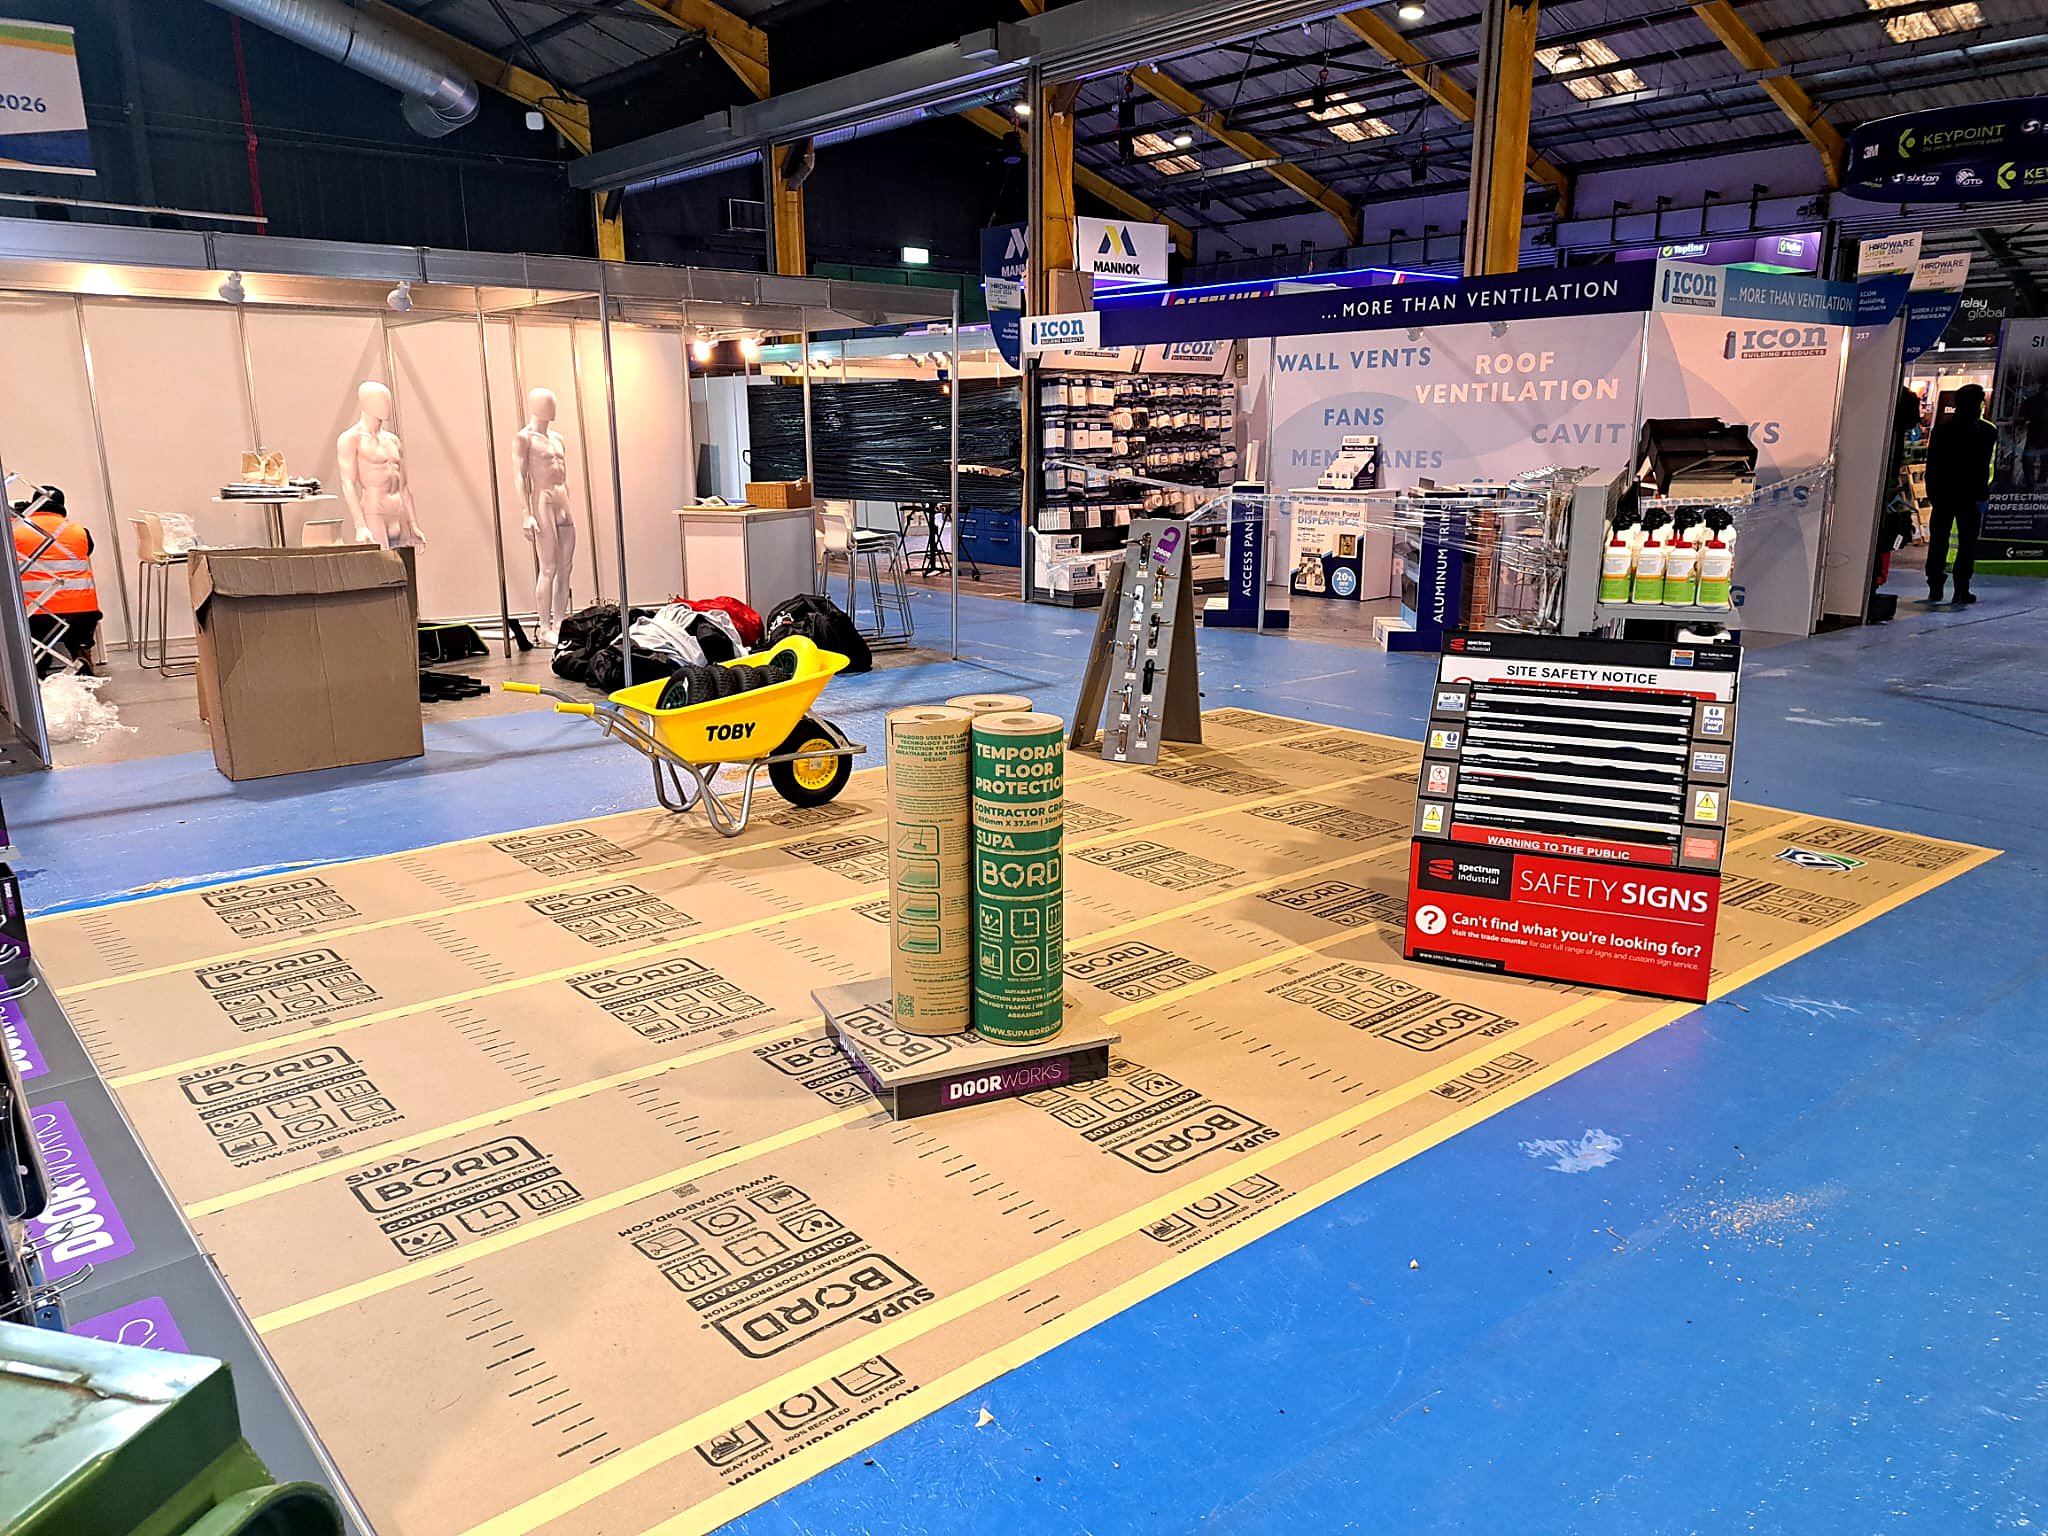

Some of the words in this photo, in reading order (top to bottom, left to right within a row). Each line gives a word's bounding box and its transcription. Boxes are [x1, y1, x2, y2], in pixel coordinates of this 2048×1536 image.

[1923, 125, 2006, 145] KEYPOINT
[1863, 144, 1879, 159] 3M
[1906, 173, 1939, 183] sixton
[1674, 244, 1705, 255] Topline
[1093, 261, 1140, 275] MANNOK
[1402, 294, 1457, 313] THAN
[1467, 279, 1619, 308] VENTILATION
[1769, 289, 1794, 306] THAN
[1797, 293, 1853, 312] VENTILATION
[1967, 307, 2006, 320] global
[1277, 350, 1340, 373] WALL
[1350, 346, 1432, 370] VENTS
[1475, 351, 1555, 375] ROOF
[1782, 349, 1826, 358] PRODUCTS
[1415, 377, 1619, 405] VENTILATION
[1323, 407, 1385, 426] FANS
[1243, 501, 1256, 548] PANELS
[1438, 502, 1452, 545] TRIMS
[1241, 551, 1253, 597] ACCESS
[1433, 549, 1450, 624] ALUMINUM
[1506, 665, 1537, 677] SITE
[1541, 667, 1598, 681] SAFETY
[1602, 671, 1658, 686] NOTICE
[705, 722, 756, 742] TOBY
[975, 742, 1064, 761] TEMPORAR
[995, 762, 1054, 779] FLOOR
[975, 776, 1064, 795] PROTECTIO
[975, 803, 1045, 818] CONTRACTOR
[1272, 803, 1319, 819] BORD
[507, 832, 583, 850] BORD
[801, 837, 871, 857] BORD
[977, 829, 1015, 849] SUPA
[1487, 835, 1541, 851] WARNING
[1543, 842, 1559, 852] TO
[1561, 843, 1586, 856] THE
[1587, 847, 1631, 861] PUBLIC
[1095, 842, 1155, 863] BORD
[981, 859, 1060, 889] BORD
[1458, 863, 1501, 876] spectrum
[1458, 873, 1500, 886] industrial
[217, 881, 314, 904] BORD
[546, 888, 634, 912] BORD
[1285, 884, 1351, 907] BORD
[1519, 869, 1618, 902] SAFETY
[1620, 881, 1709, 914] SIGNS
[1451, 928, 1466, 938] Visit
[1467, 930, 1480, 940] the
[1480, 932, 1499, 943] trade
[1500, 935, 1529, 946] counter
[1537, 941, 1551, 949] our
[1552, 942, 1564, 951] full
[1565, 945, 1585, 956] range
[1586, 947, 1594, 956] of
[1595, 949, 1612, 960] signs
[1613, 950, 1628, 961] and
[1628, 953, 1656, 964] custom
[1656, 957, 1672, 969] sign
[1452, 912, 1488, 929] Can't
[1490, 917, 1519, 933] find
[1522, 922, 1558, 939] what
[1561, 929, 1607, 948] you're
[1610, 932, 1669, 956] looking
[1671, 941, 1702, 959] for?
[194, 959, 256, 974] SUPA
[214, 953, 326, 984] BORD
[1068, 946, 1150, 975] BORD
[565, 969, 618, 985] SUPA
[590, 962, 691, 994] BORD
[844, 1015, 933, 1058] BORD
[1400, 1008, 1484, 1045] BORD
[1478, 1018, 1520, 1038] SUPA
[752, 1037, 809, 1057] SUPA
[178, 1062, 249, 1084] SUPA
[202, 1053, 335, 1096] BORD
[950, 1063, 1062, 1100] DOORWORKS
[197, 1091, 260, 1112] TEMPORARY
[262, 1080, 298, 1095] FLOOR
[203, 1087, 301, 1119] CONTRACTOR
[311, 1070, 365, 1089] GRADE
[1126, 1091, 1197, 1124] CONTRACTOR
[234, 1115, 406, 1169] WWW.SUPABORD.COM
[1086, 1119, 1126, 1140] GRADE
[1134, 1114, 1242, 1163] BORD
[1226, 1128, 1281, 1153] SUPA
[346, 1157, 422, 1185] SUPA
[375, 1146, 521, 1202] BORD
[375, 1194, 444, 1222] TEMPORARY
[446, 1182, 482, 1198] FLOOR
[484, 1160, 552, 1187] PROTECTION
[385, 1189, 500, 1232] CONTRACTOR
[501, 1168, 560, 1190] GRADE
[617, 1174, 779, 1238] WWW.SUPABORD.COM
[1167, 1236, 1187, 1249] HEAVY
[1187, 1229, 1203, 1239] DUTY
[752, 1235, 858, 1282] CONTRACTOR
[812, 1244, 873, 1274] TEMPORARY
[774, 1269, 812, 1289] FLOOR
[692, 1280, 752, 1308] GRADE
[702, 1284, 778, 1320] PROTECTION
[743, 1266, 894, 1341] BORD
[857, 1287, 936, 1326] SUPA
[860, 1392, 878, 1404] CUT
[886, 1378, 907, 1390] FOLD
[783, 1430, 808, 1443] 100%
[808, 1407, 851, 1431] RECYCLED
[719, 1457, 749, 1477] HEAVY
[751, 1446, 775, 1461] DUTY
